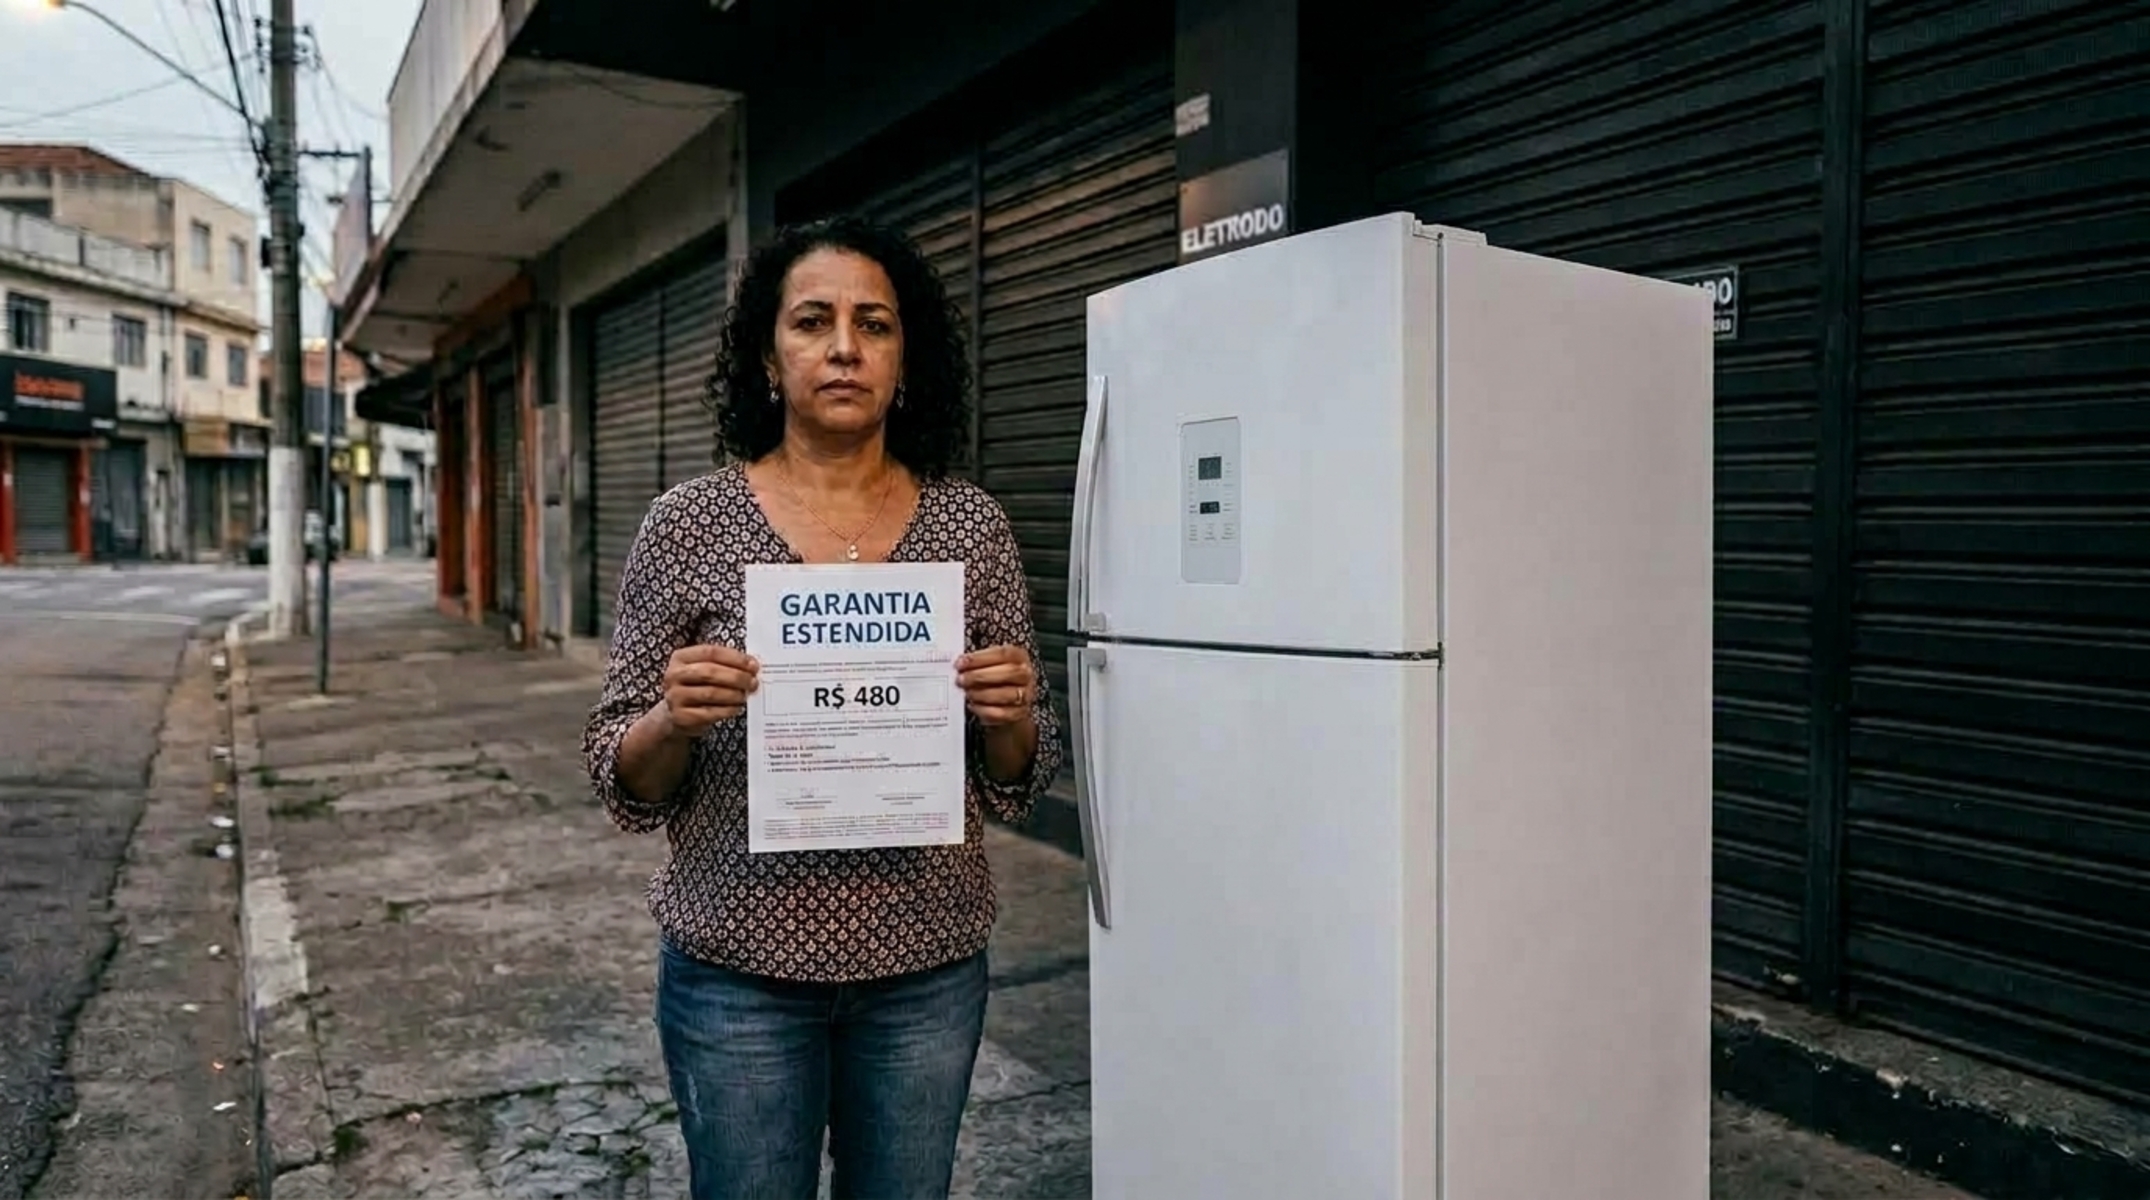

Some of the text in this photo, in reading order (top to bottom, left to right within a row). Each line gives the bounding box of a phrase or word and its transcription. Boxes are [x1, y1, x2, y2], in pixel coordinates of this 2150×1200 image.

[1182, 203, 1284, 254] ELETRODO
[780, 592, 932, 617] GARANTIA
[782, 621, 932, 645] ESTENDIDA
[813, 683, 901, 710] R$ 480
